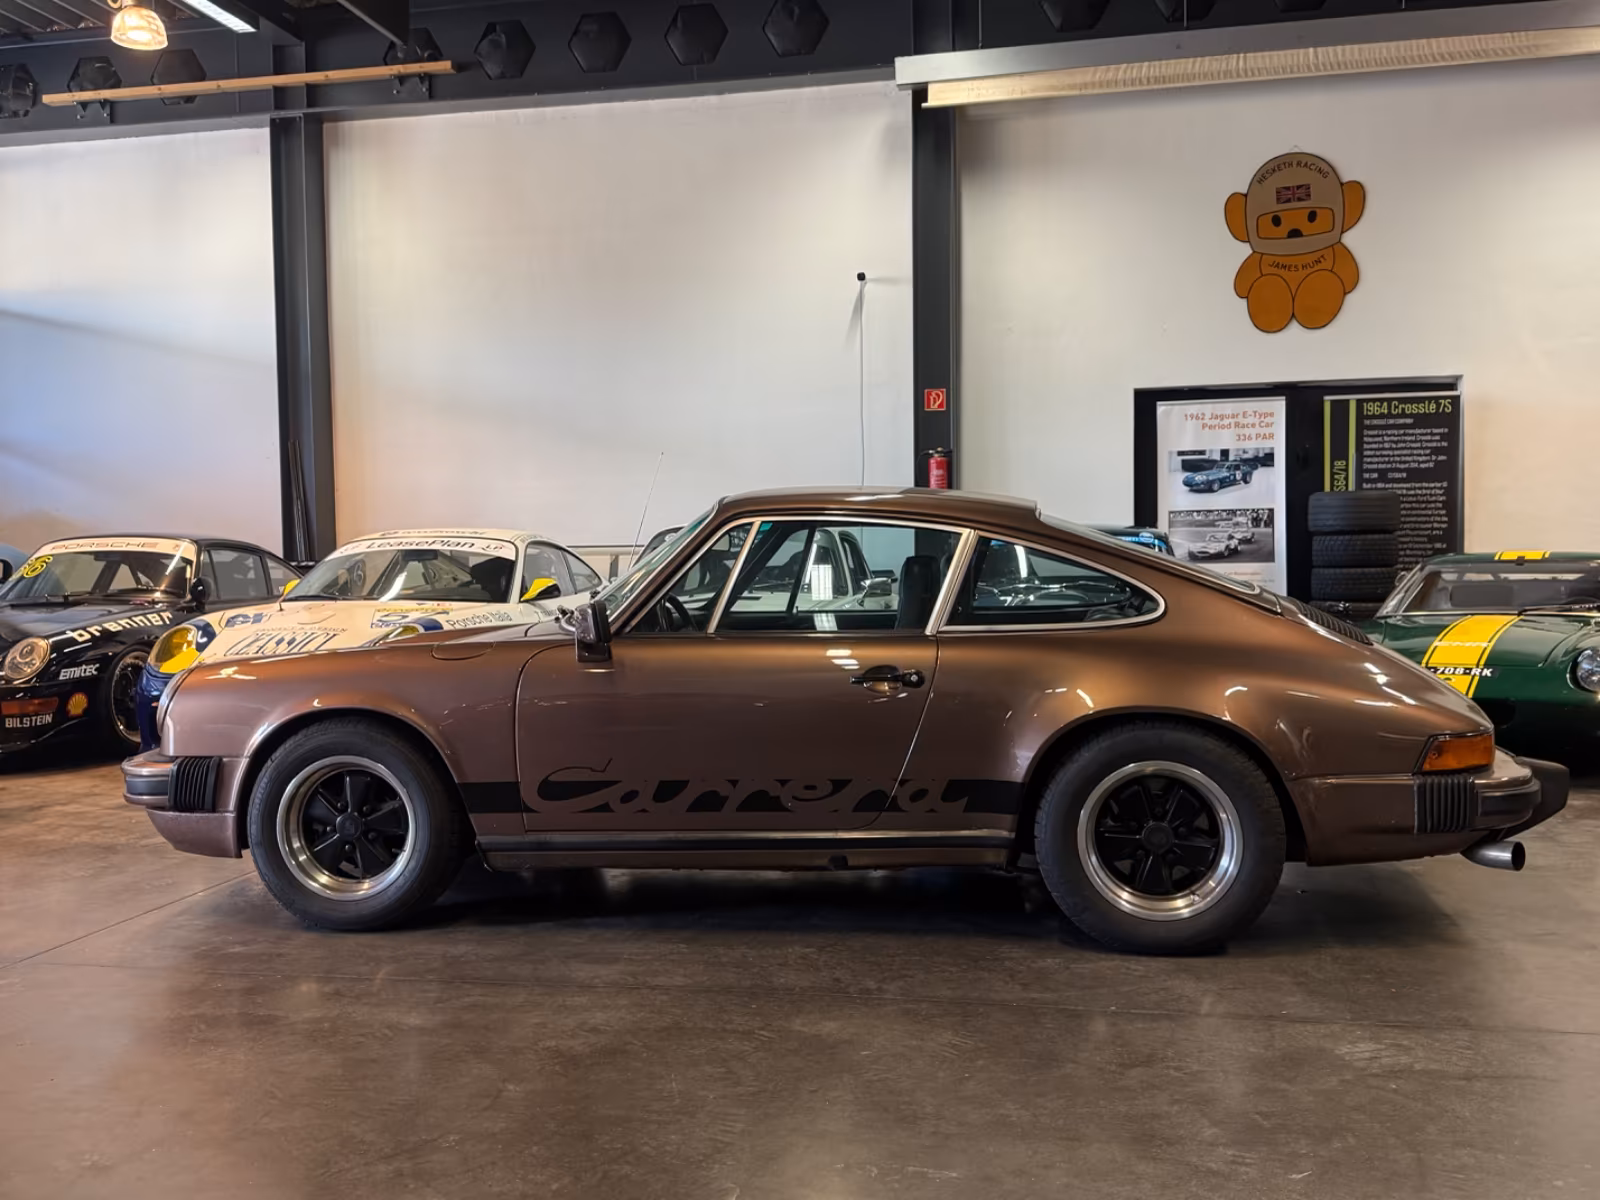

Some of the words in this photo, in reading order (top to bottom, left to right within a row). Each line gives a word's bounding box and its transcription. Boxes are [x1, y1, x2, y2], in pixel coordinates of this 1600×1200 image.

[1256, 161, 1294, 185] HESKETH
[1295, 160, 1330, 180] RACING
[1268, 260, 1300, 272] JAMES
[1301, 254, 1328, 271] HUNT
[1363, 402, 1388, 416] 1964
[1391, 400, 1436, 414] Crosslé
[1438, 399, 1452, 413] 7S
[1184, 412, 1206, 421] 1962
[1208, 411, 1239, 422] Jaguar
[1242, 410, 1275, 421] E-Type
[1201, 421, 1232, 431] Period
[1234, 421, 1257, 430] Race
[1258, 421, 1275, 429] Car
[1235, 434, 1253, 442] 336
[1255, 433, 1275, 441] PAR
[51, 541, 160, 552] PORSCHE
[366, 539, 476, 550] LeasePlan
[445, 612, 493, 629] Porsche
[490, 610, 513, 622] Italia
[5, 713, 53, 728] BILSTEIN
[521, 757, 970, 814] Carrera
